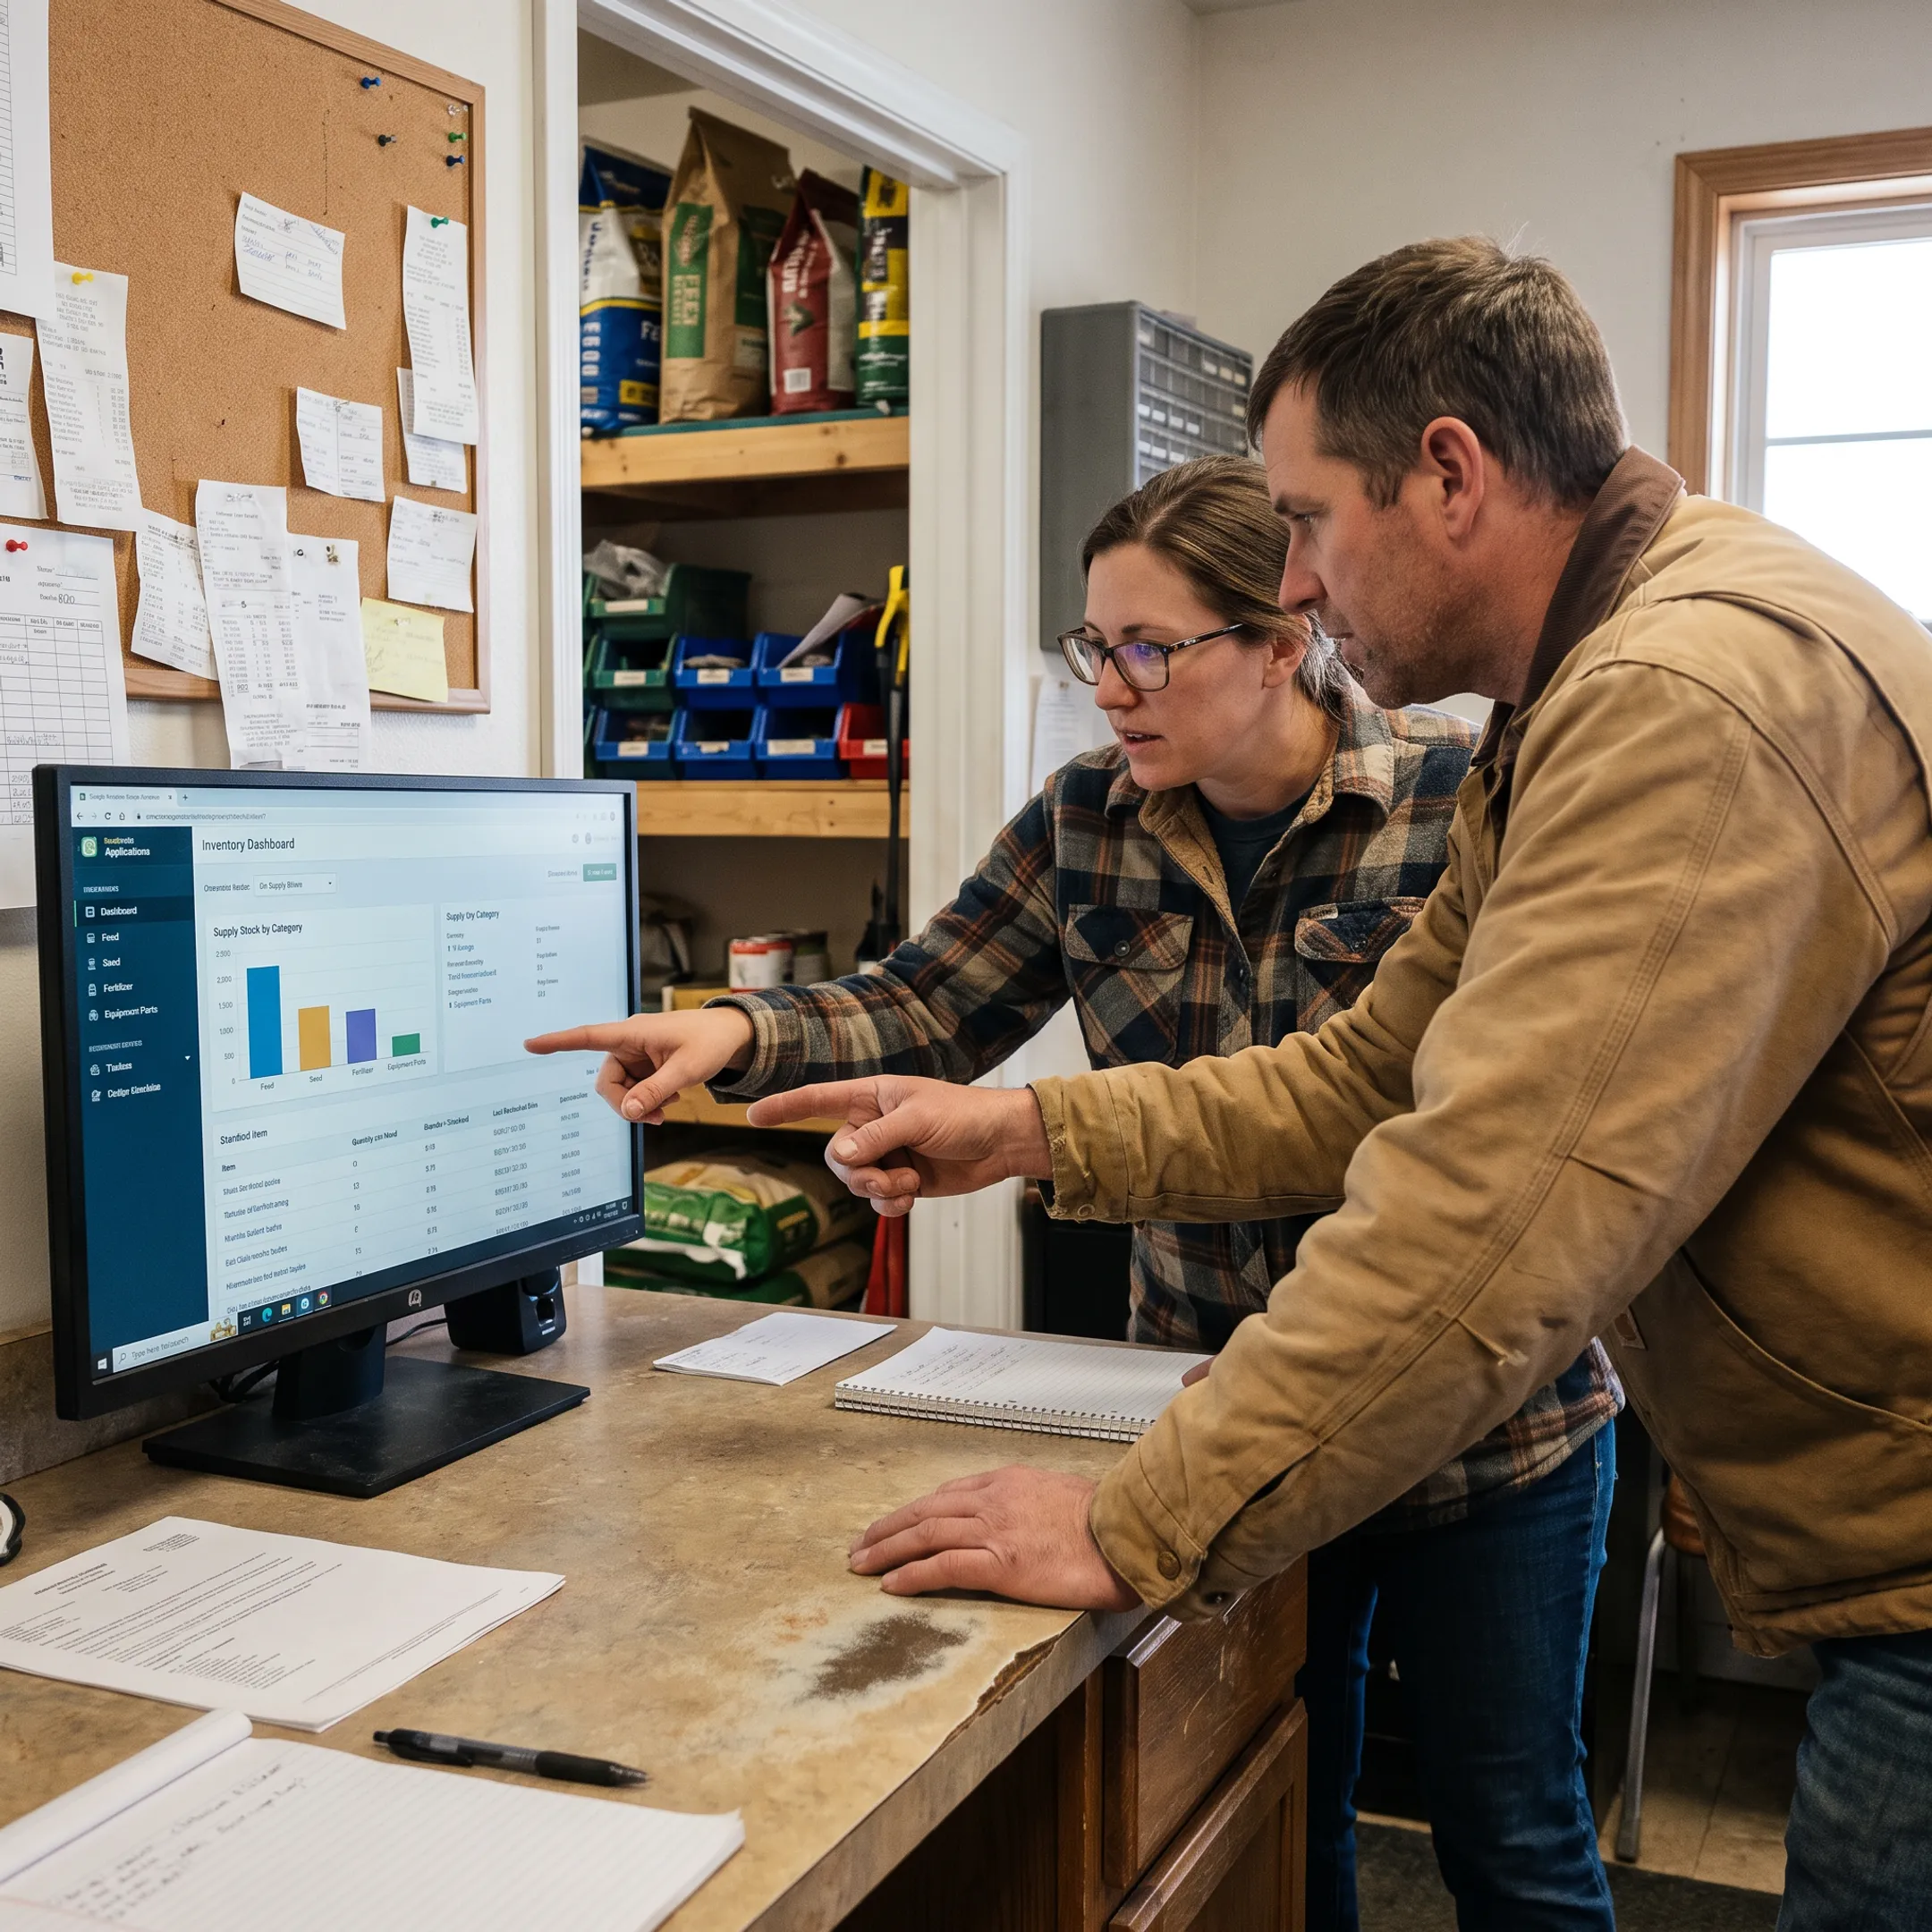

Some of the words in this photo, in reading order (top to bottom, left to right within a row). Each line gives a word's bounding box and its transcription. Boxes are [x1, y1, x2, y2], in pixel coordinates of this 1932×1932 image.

[202, 839, 245, 853] Inventory
[248, 837, 295, 850] Dashboard
[101, 932, 120, 942] Feed
[213, 926, 239, 939] Supply
[240, 925, 261, 936] Stock
[262, 924, 270, 935] by
[140, 1006, 159, 1015] Parts
